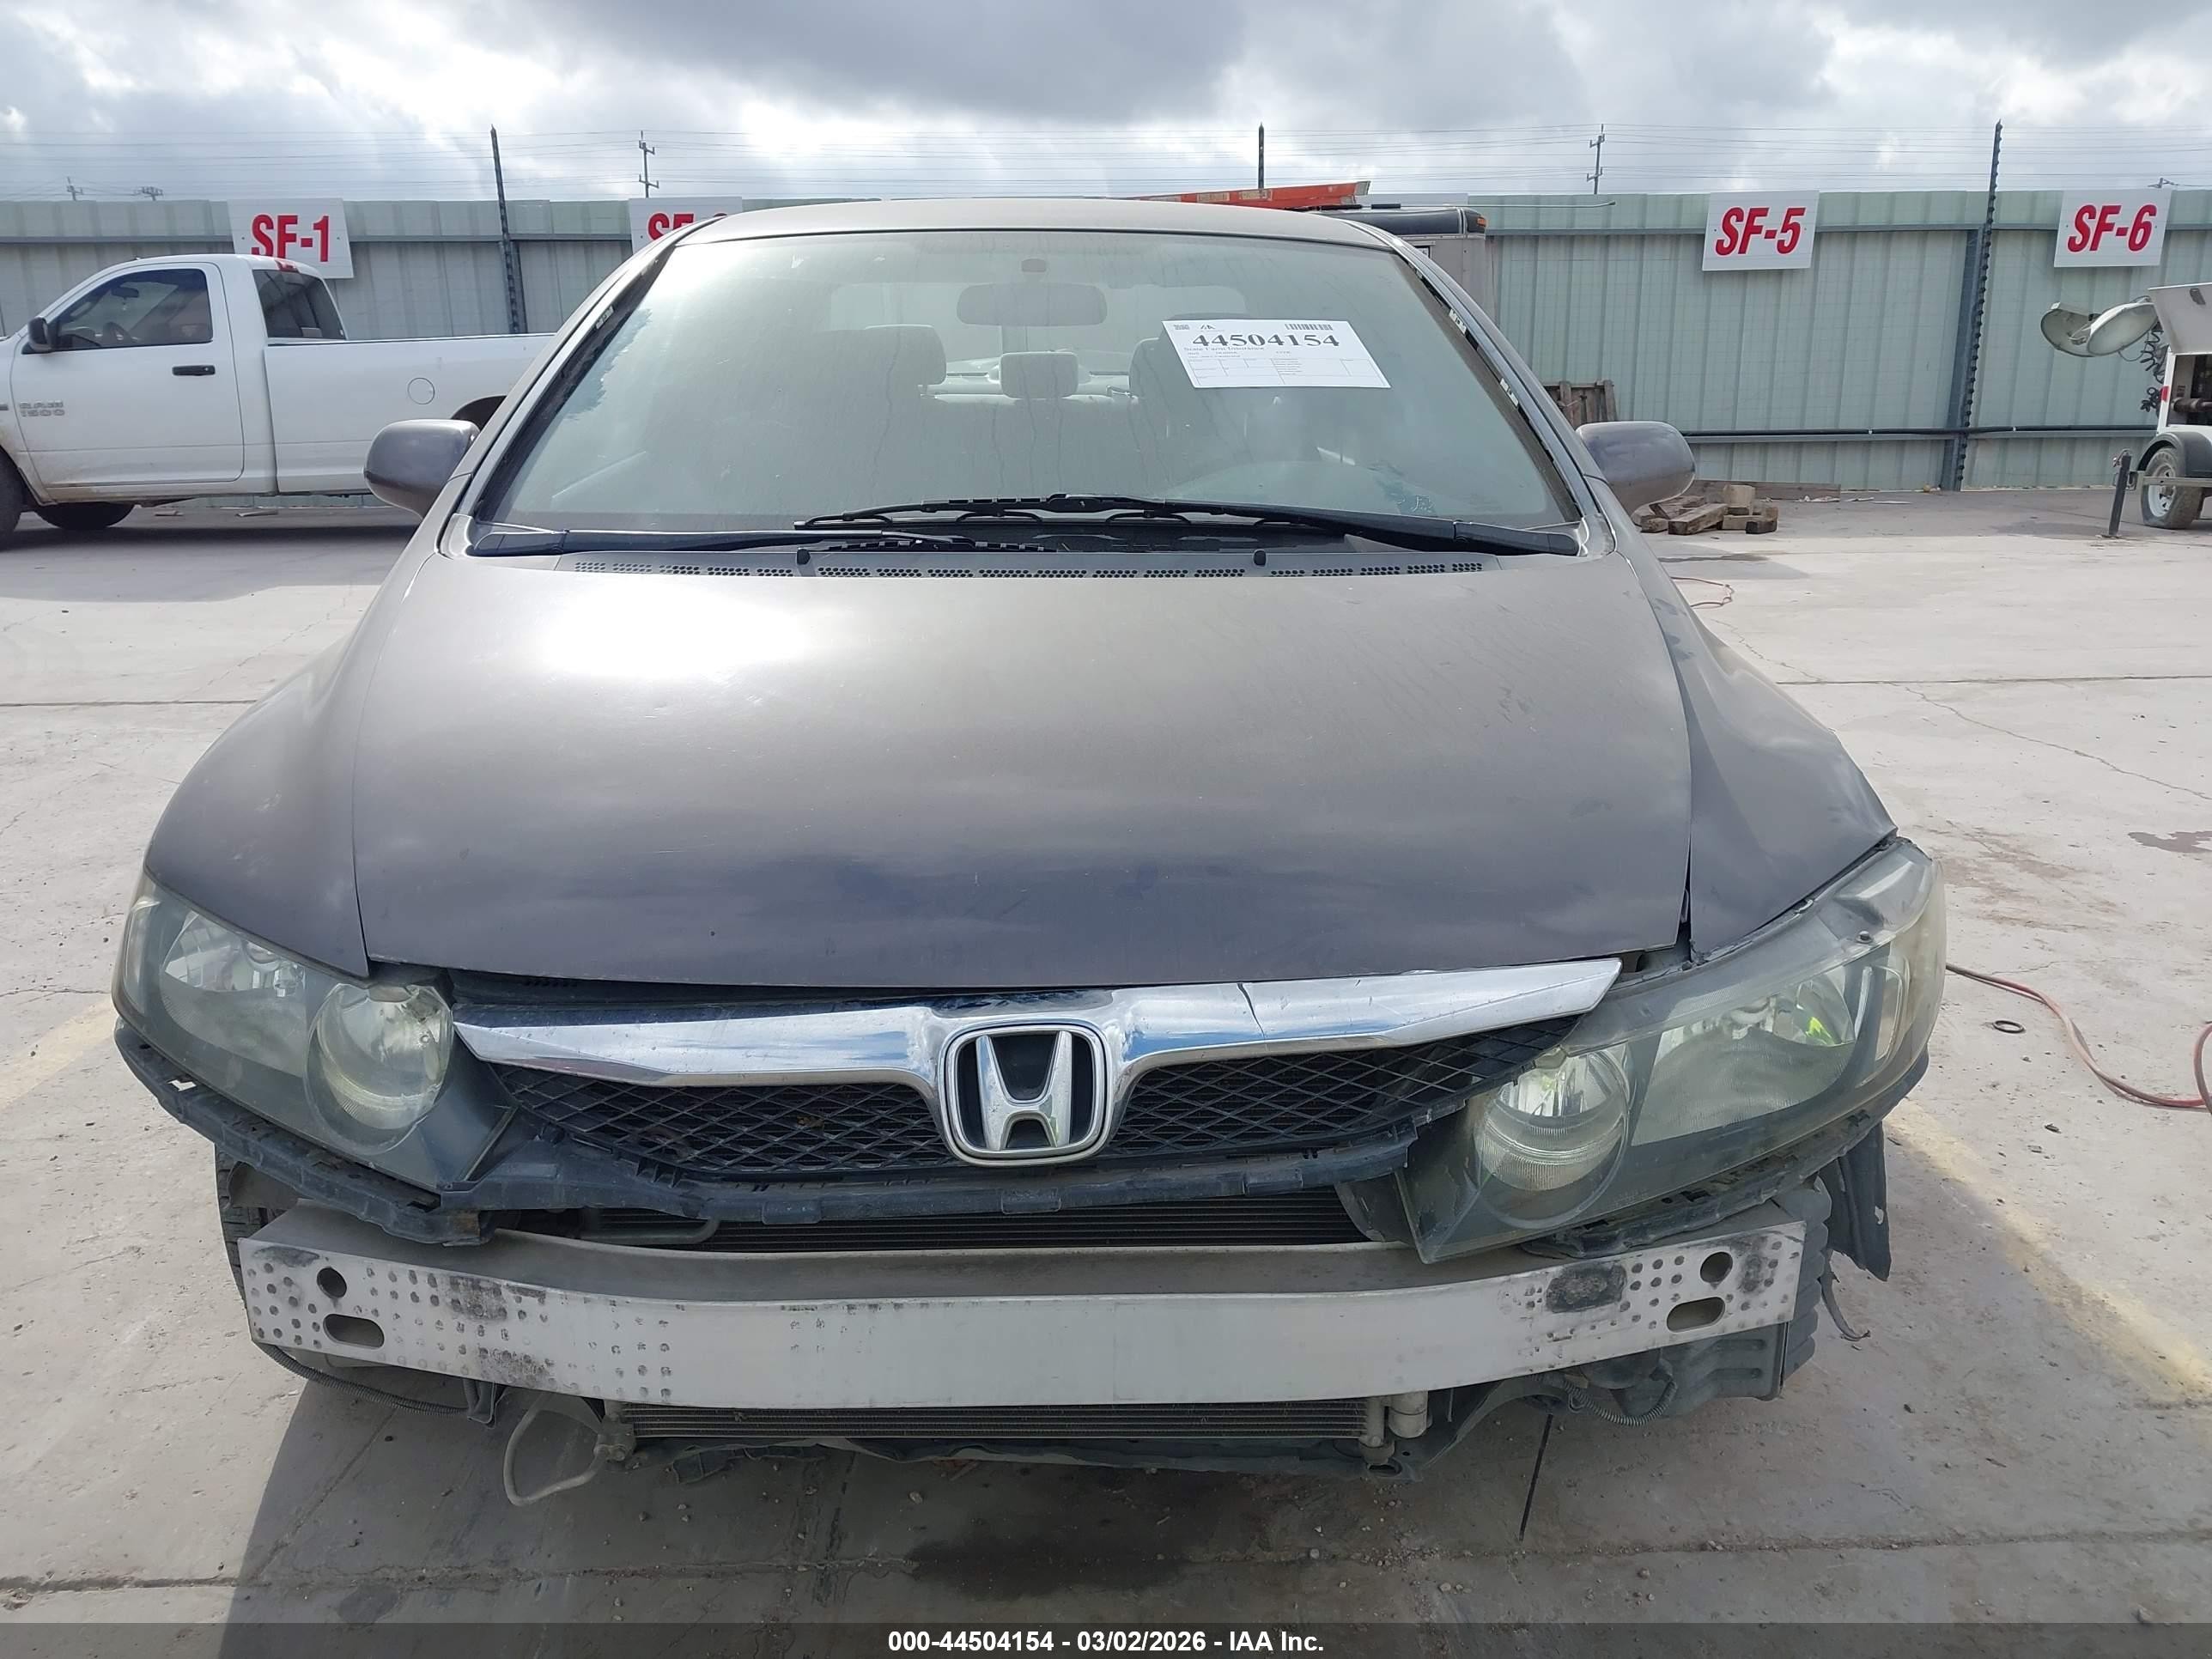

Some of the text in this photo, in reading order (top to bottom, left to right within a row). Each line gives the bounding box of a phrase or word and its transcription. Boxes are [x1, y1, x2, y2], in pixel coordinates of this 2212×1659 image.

[251, 213, 330, 262] SF-1
[1715, 206, 1806, 256] SF-5
[2066, 204, 2158, 253] SF-6
[1192, 333, 1340, 347] 44504154
